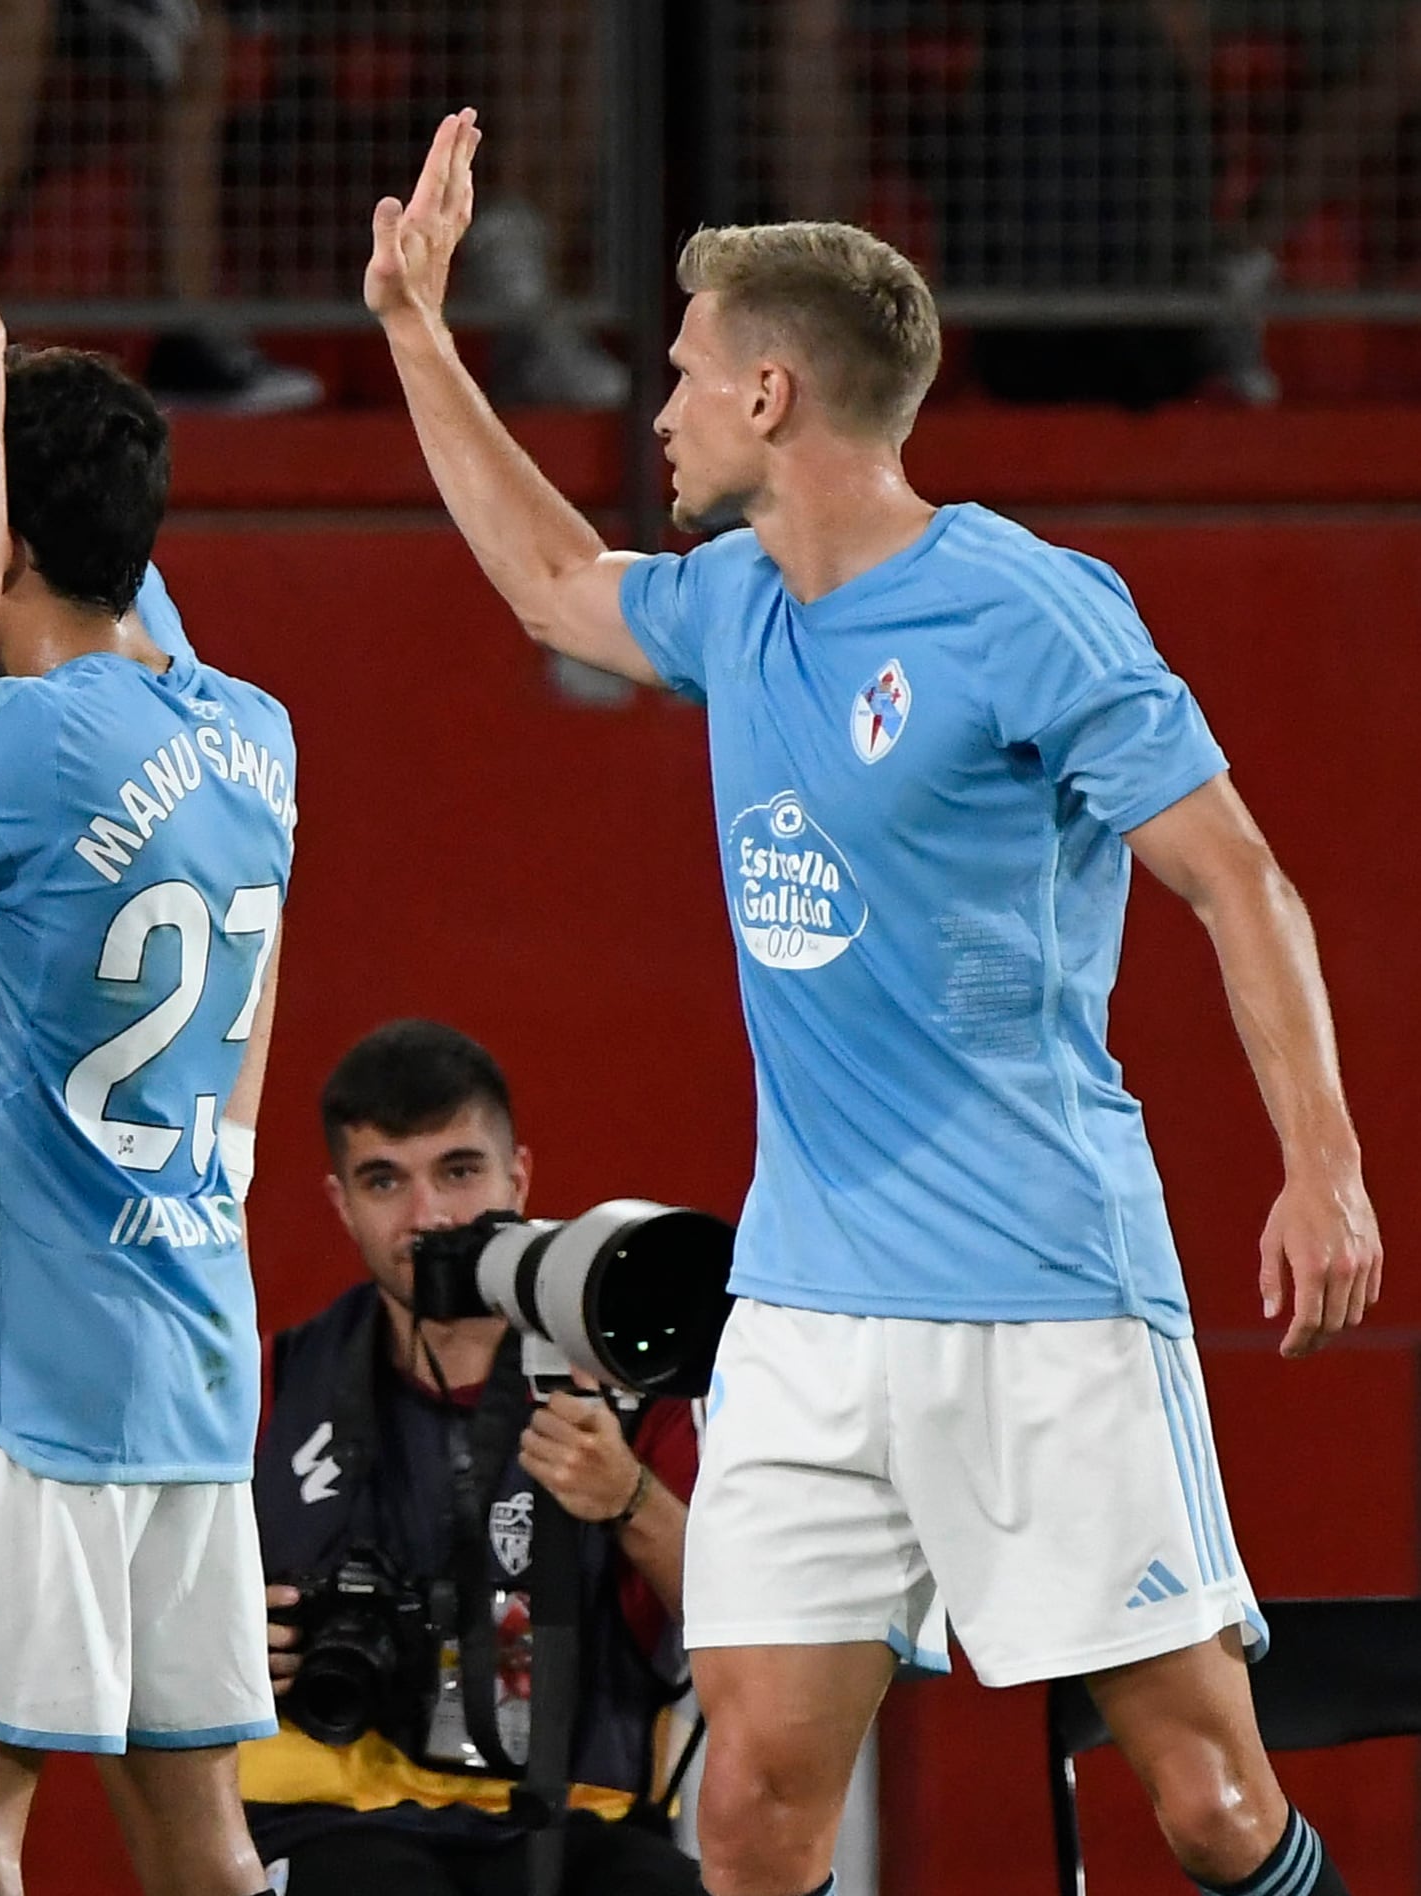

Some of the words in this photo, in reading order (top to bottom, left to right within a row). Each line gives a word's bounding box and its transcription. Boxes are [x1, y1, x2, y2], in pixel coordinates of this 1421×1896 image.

[74, 731, 202, 884] MANU
[738, 836, 841, 893] Estrella
[743, 879, 832, 929] Galicia
